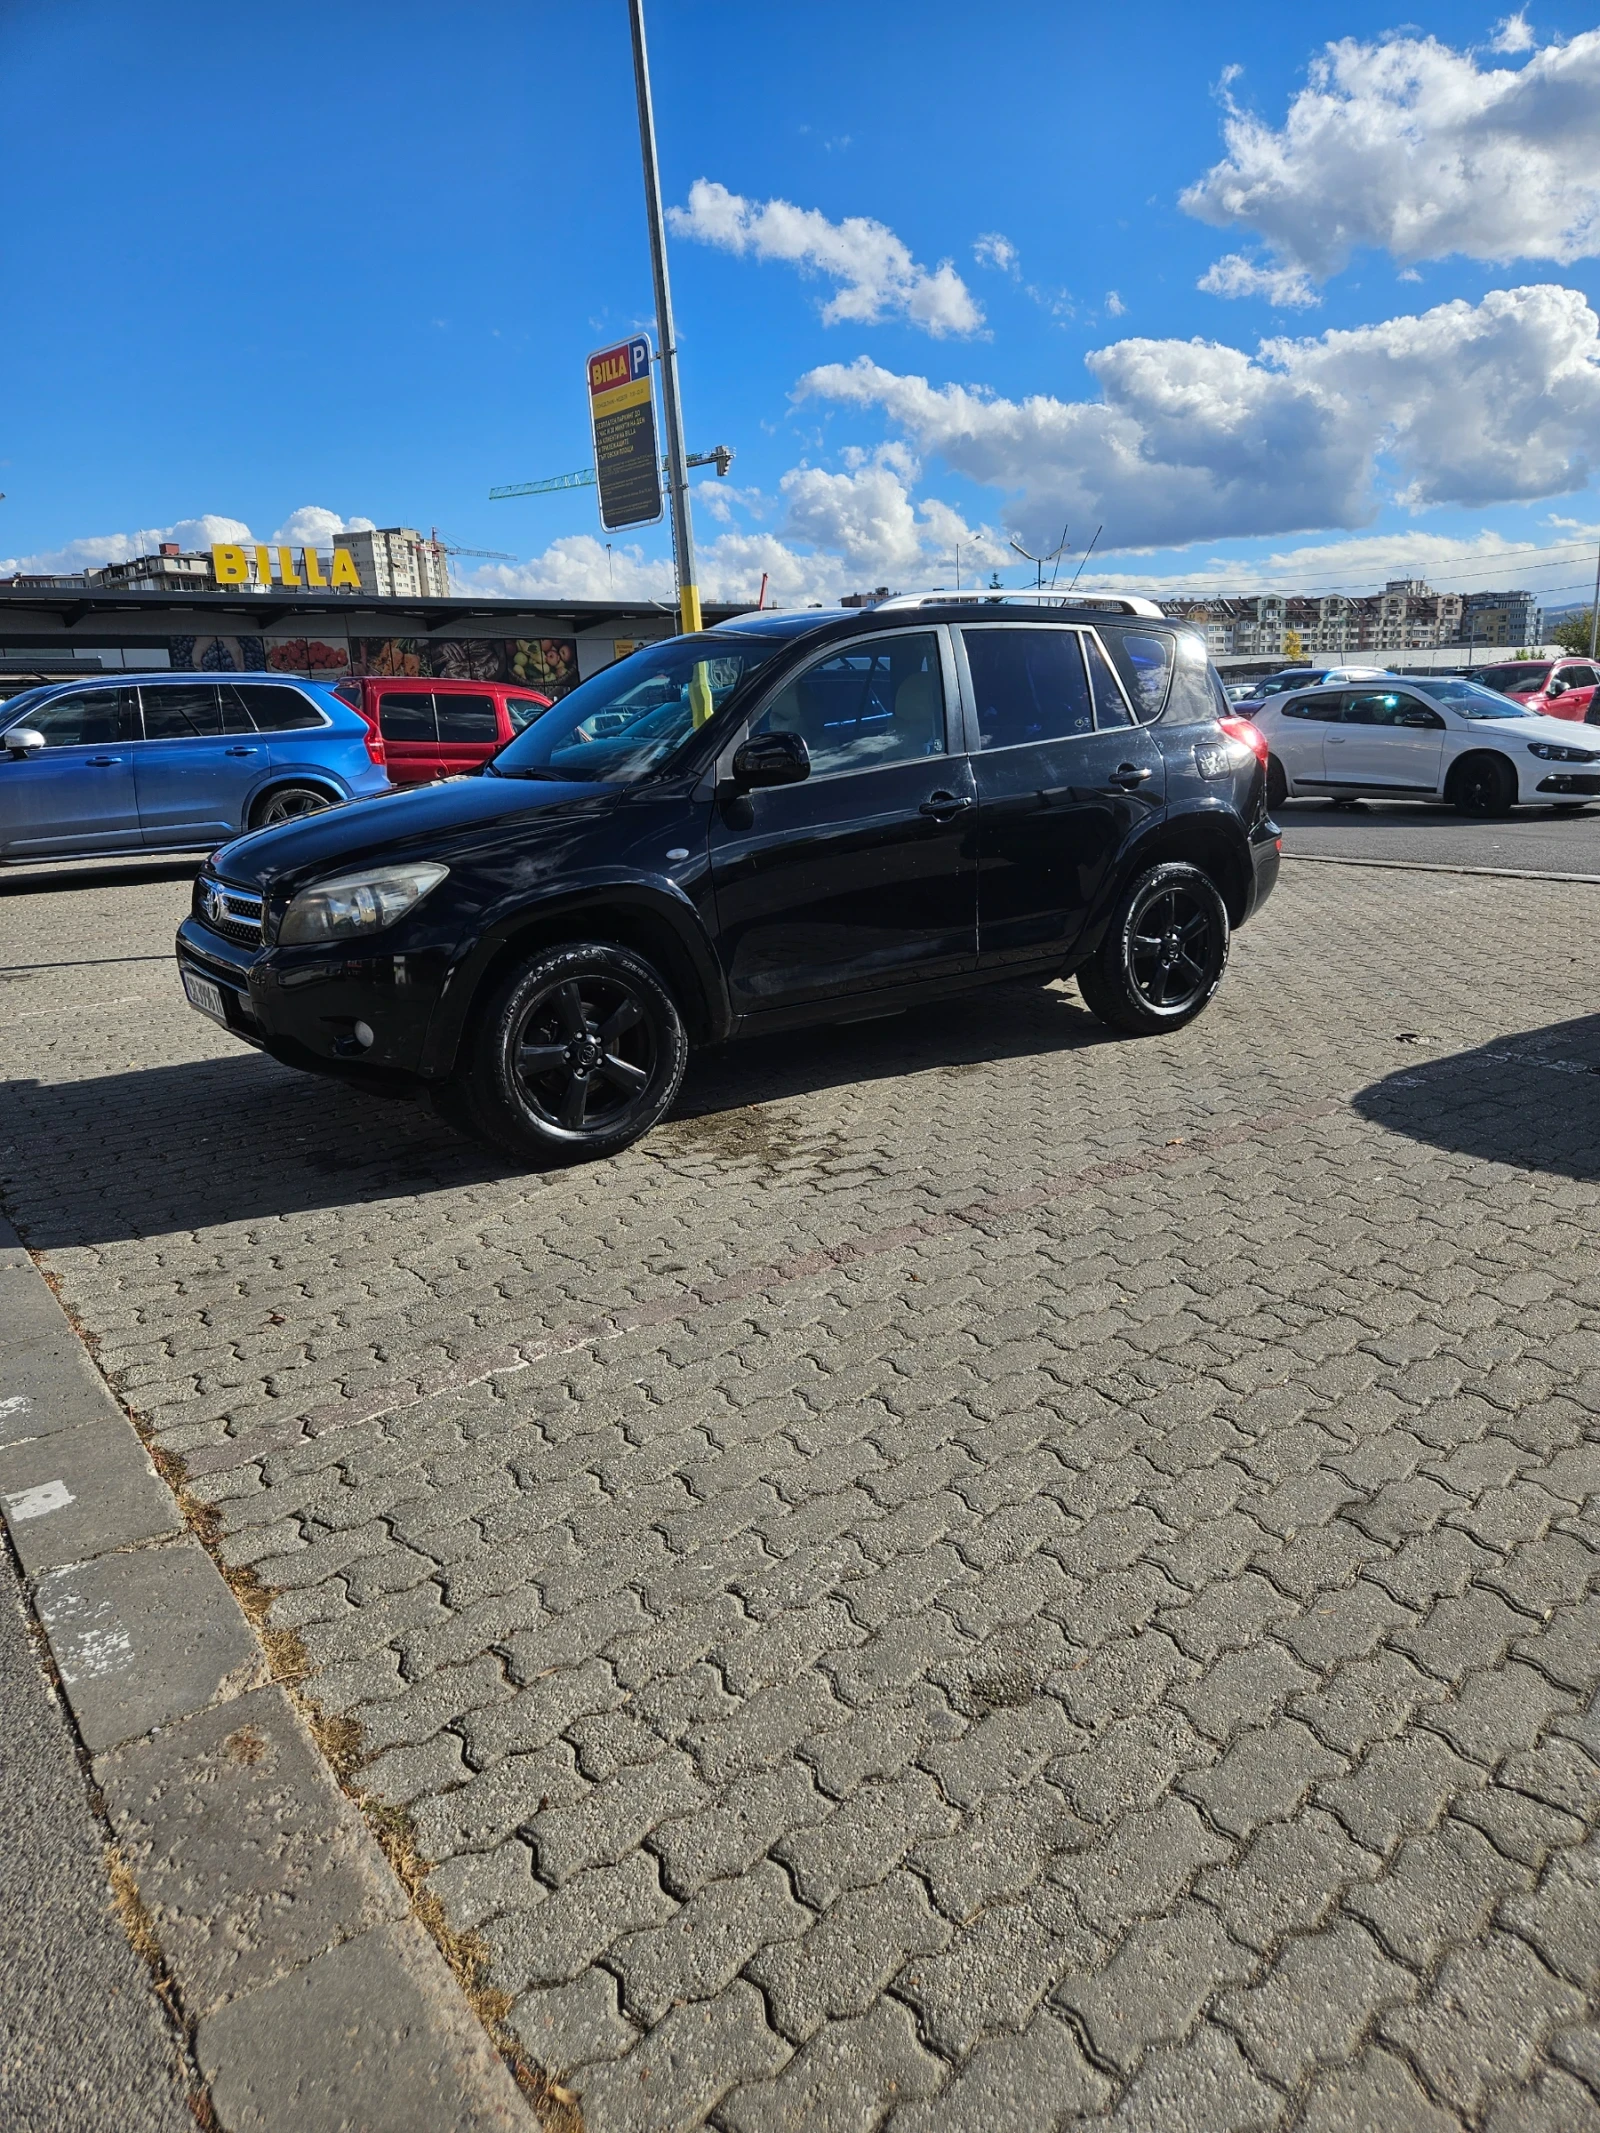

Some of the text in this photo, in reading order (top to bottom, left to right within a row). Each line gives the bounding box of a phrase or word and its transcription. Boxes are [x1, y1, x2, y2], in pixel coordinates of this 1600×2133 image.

[592, 345, 645, 386] BILLA P
[211, 543, 362, 588] BILLA
